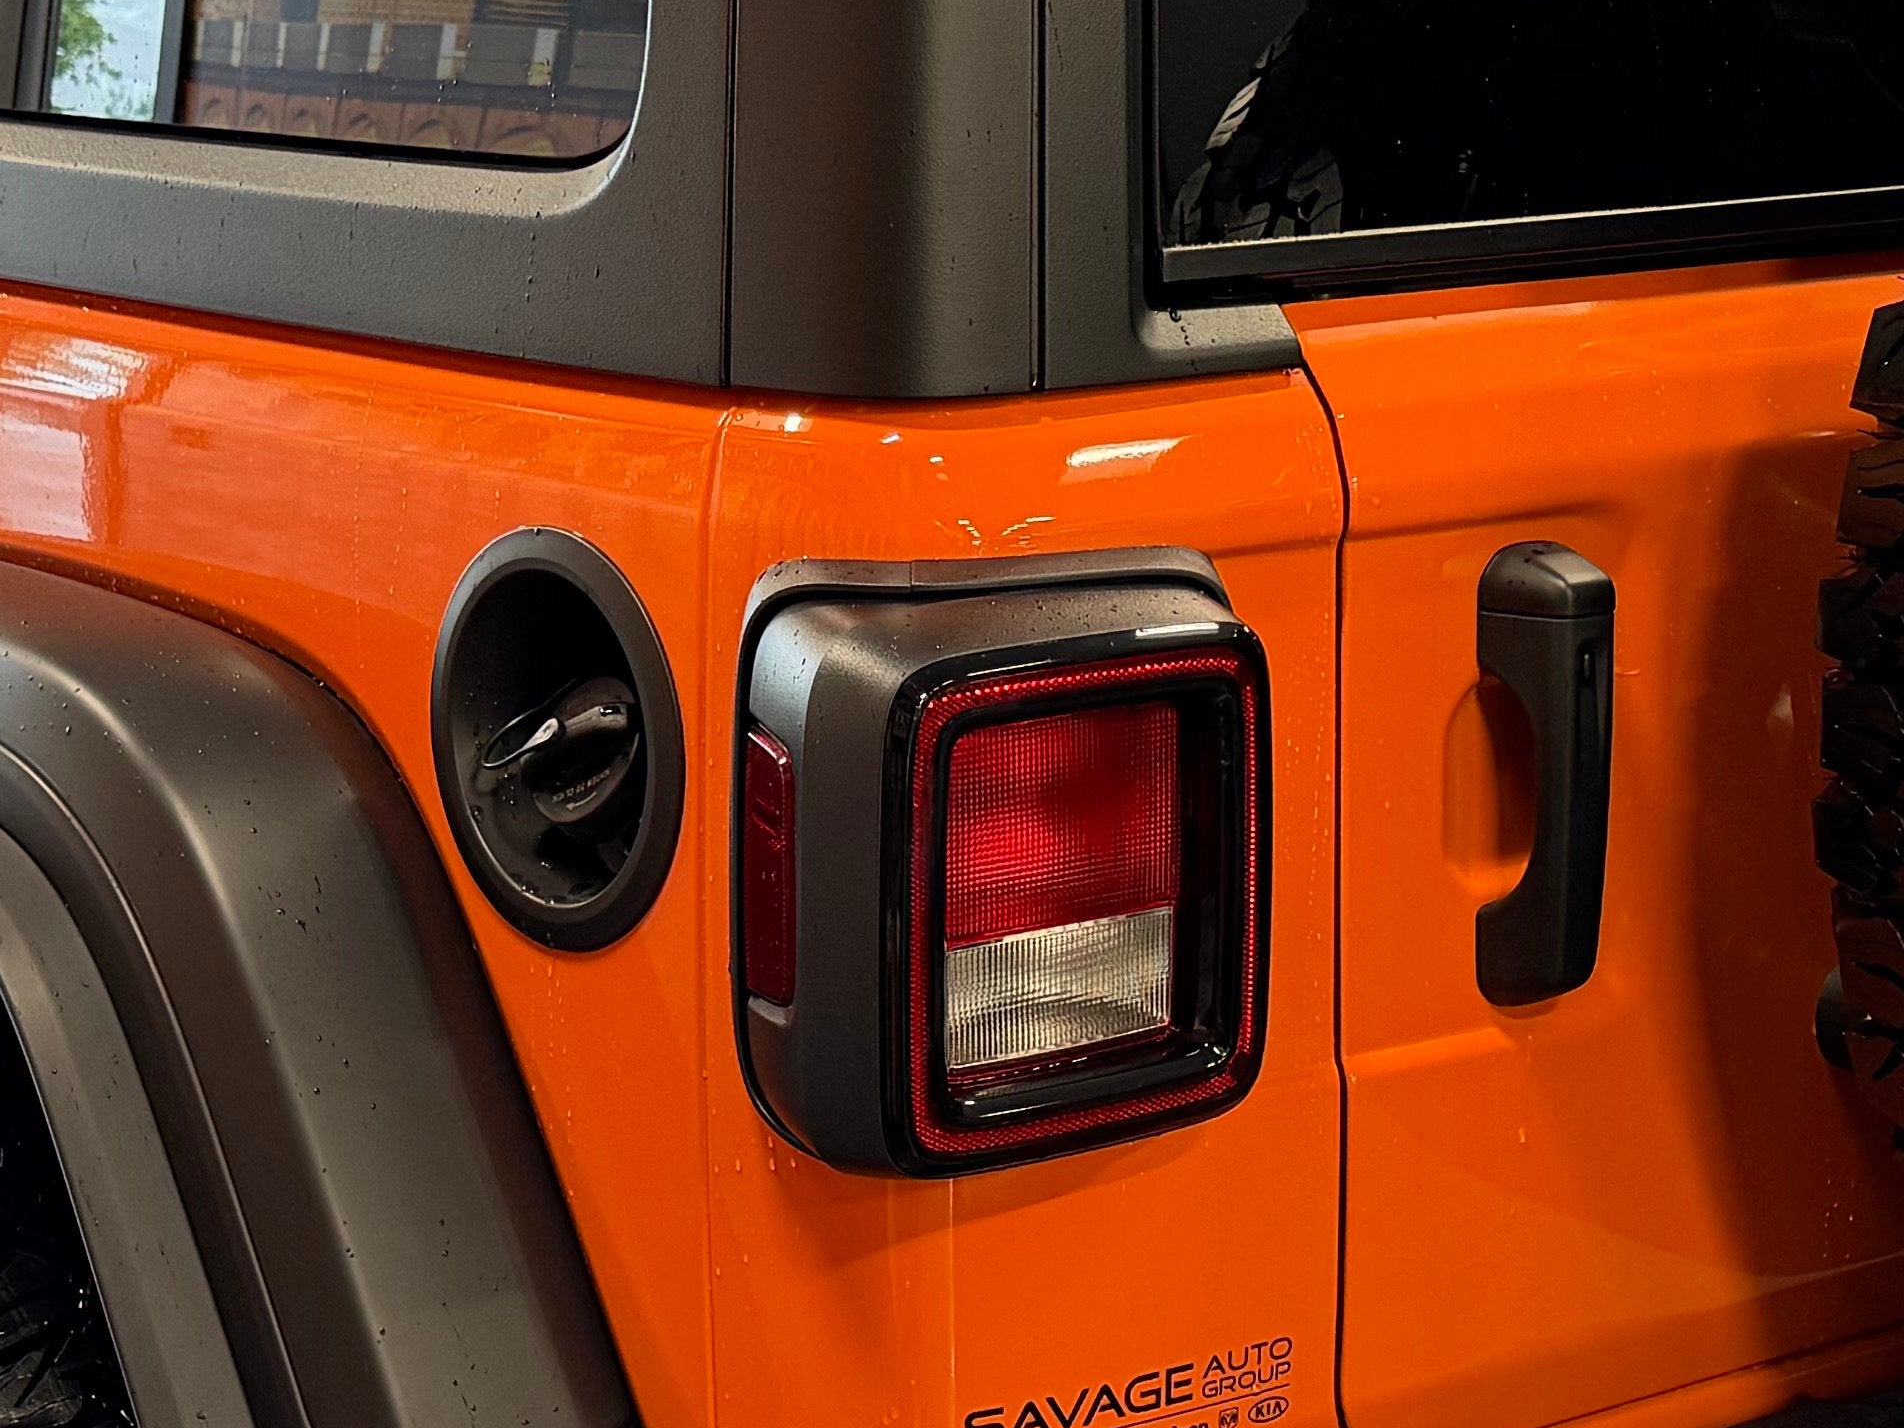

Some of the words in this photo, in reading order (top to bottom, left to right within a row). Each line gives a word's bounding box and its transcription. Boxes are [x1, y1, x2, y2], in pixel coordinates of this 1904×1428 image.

[1202, 1336, 1293, 1379] AUTO
[1201, 1360, 1292, 1400] GROUP
[1254, 1399, 1283, 1420] KIA
